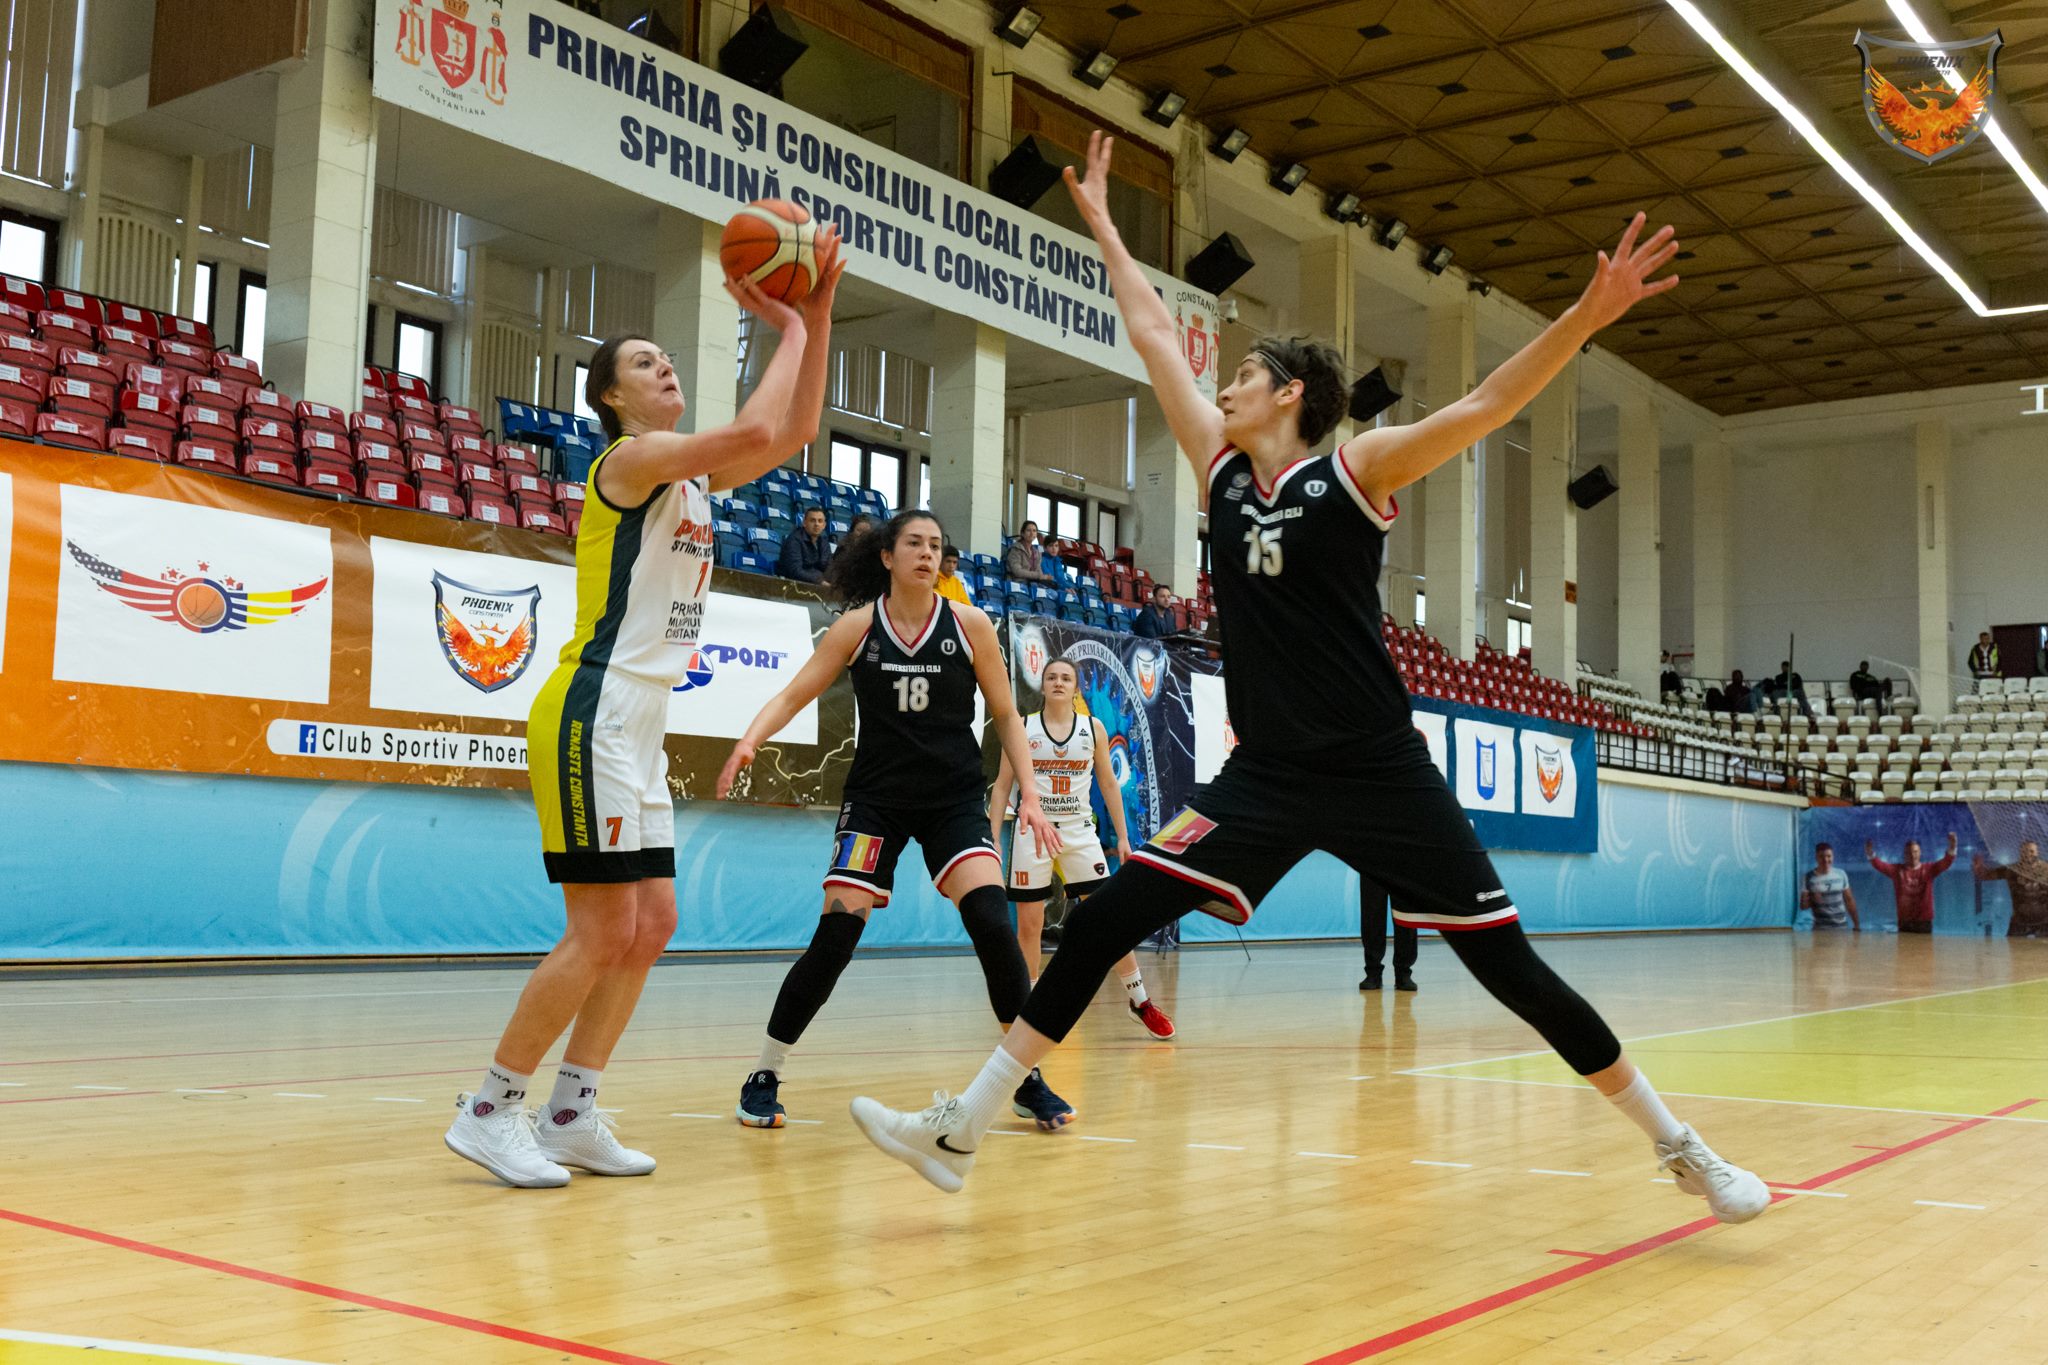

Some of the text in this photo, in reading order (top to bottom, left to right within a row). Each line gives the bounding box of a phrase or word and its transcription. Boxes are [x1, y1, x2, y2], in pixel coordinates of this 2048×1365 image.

[418, 84, 486, 116] CONSTANTIANA
[441, 87, 464, 101] TOMIS
[529, 13, 723, 136] PRIMĂRIA
[777, 122, 935, 223] CONSILIUL
[943, 192, 1023, 260] LOCAL
[1243, 524, 1284, 577] 15
[461, 596, 515, 613] PHOENIX
[881, 662, 942, 673] UNIVERSITATEA CLUJ
[892, 675, 930, 713] 18
[322, 728, 371, 754] Club
[382, 732, 459, 762] Sportiv
[1048, 775, 1071, 795] 10
[606, 816, 623, 847] 7
[1015, 871, 1029, 886] 10
